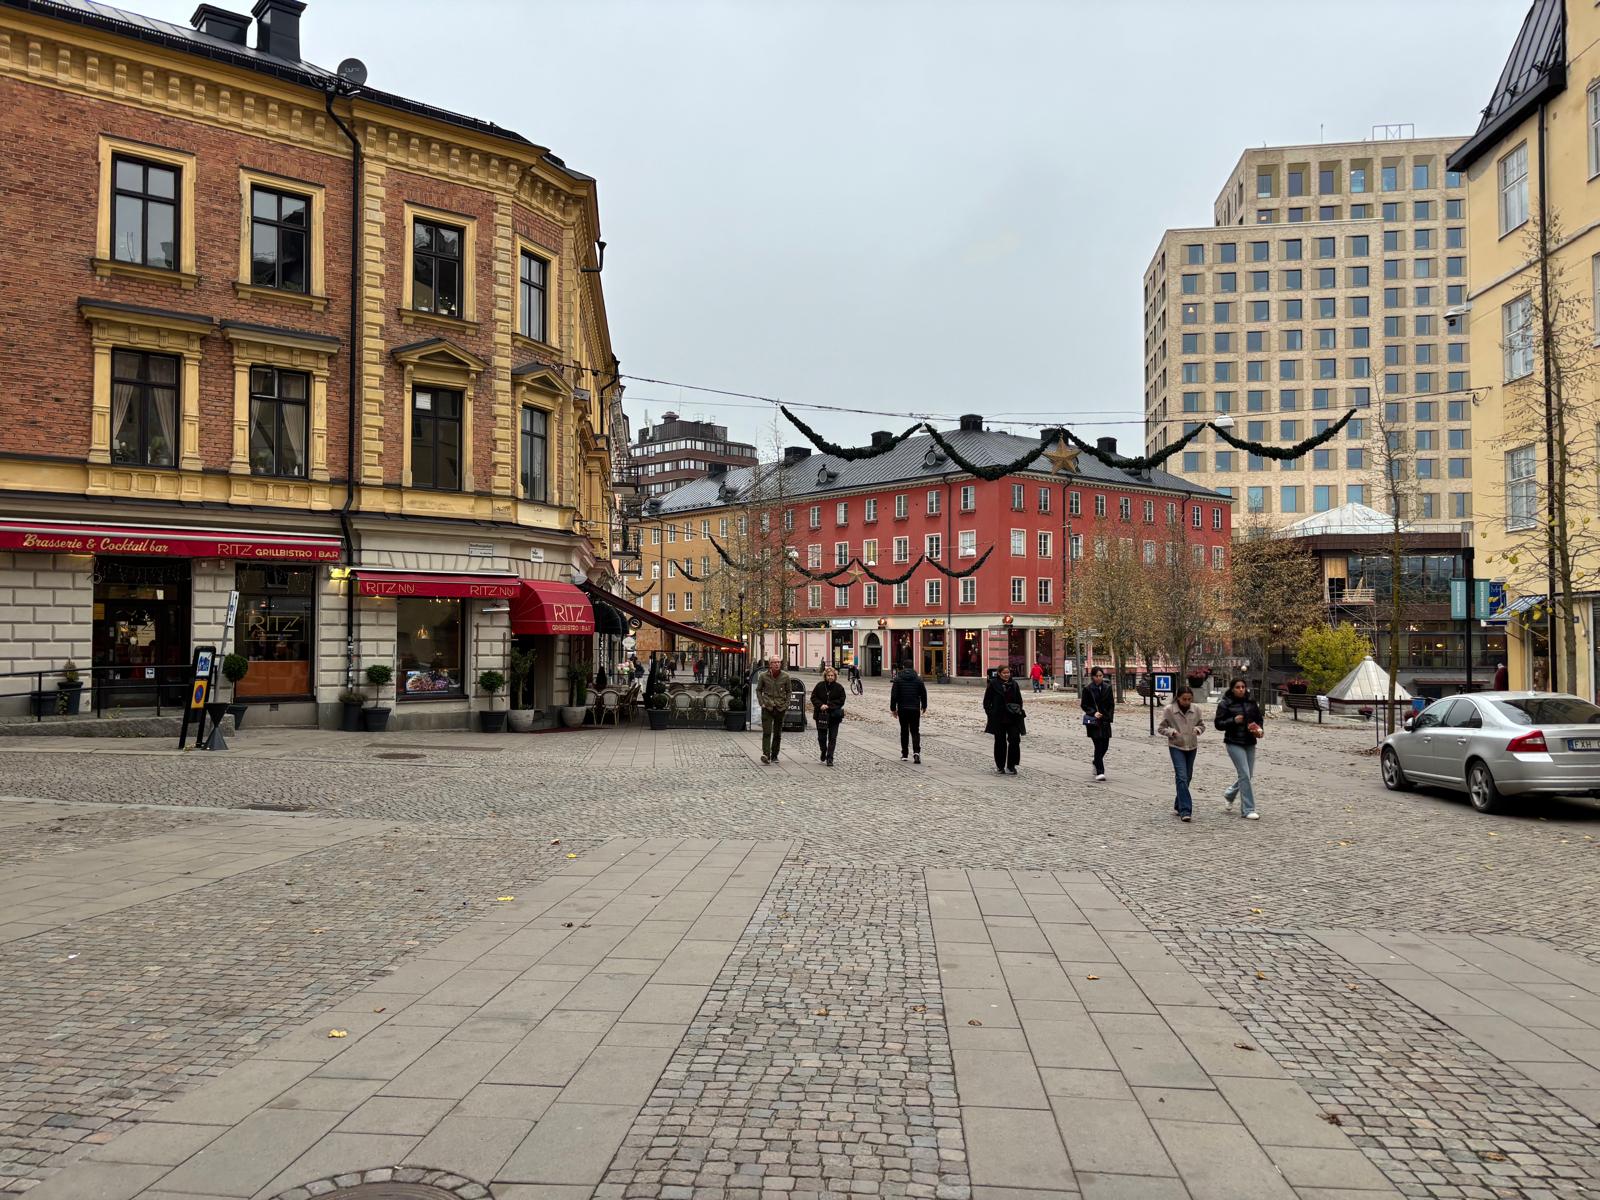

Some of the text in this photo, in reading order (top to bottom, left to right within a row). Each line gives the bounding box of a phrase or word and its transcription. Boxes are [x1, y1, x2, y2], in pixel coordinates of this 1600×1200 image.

[23, 533, 169, 552] Brasserie & Cocktail bar
[217, 543, 253, 556] RITZ
[255, 548, 313, 558] GRILLBISTRO
[366, 582, 398, 593] RITZ
[470, 585, 498, 596] RITZ
[553, 604, 586, 622] RITZ
[248, 615, 300, 632] RITZ
[1574, 740, 1592, 749] FXH
